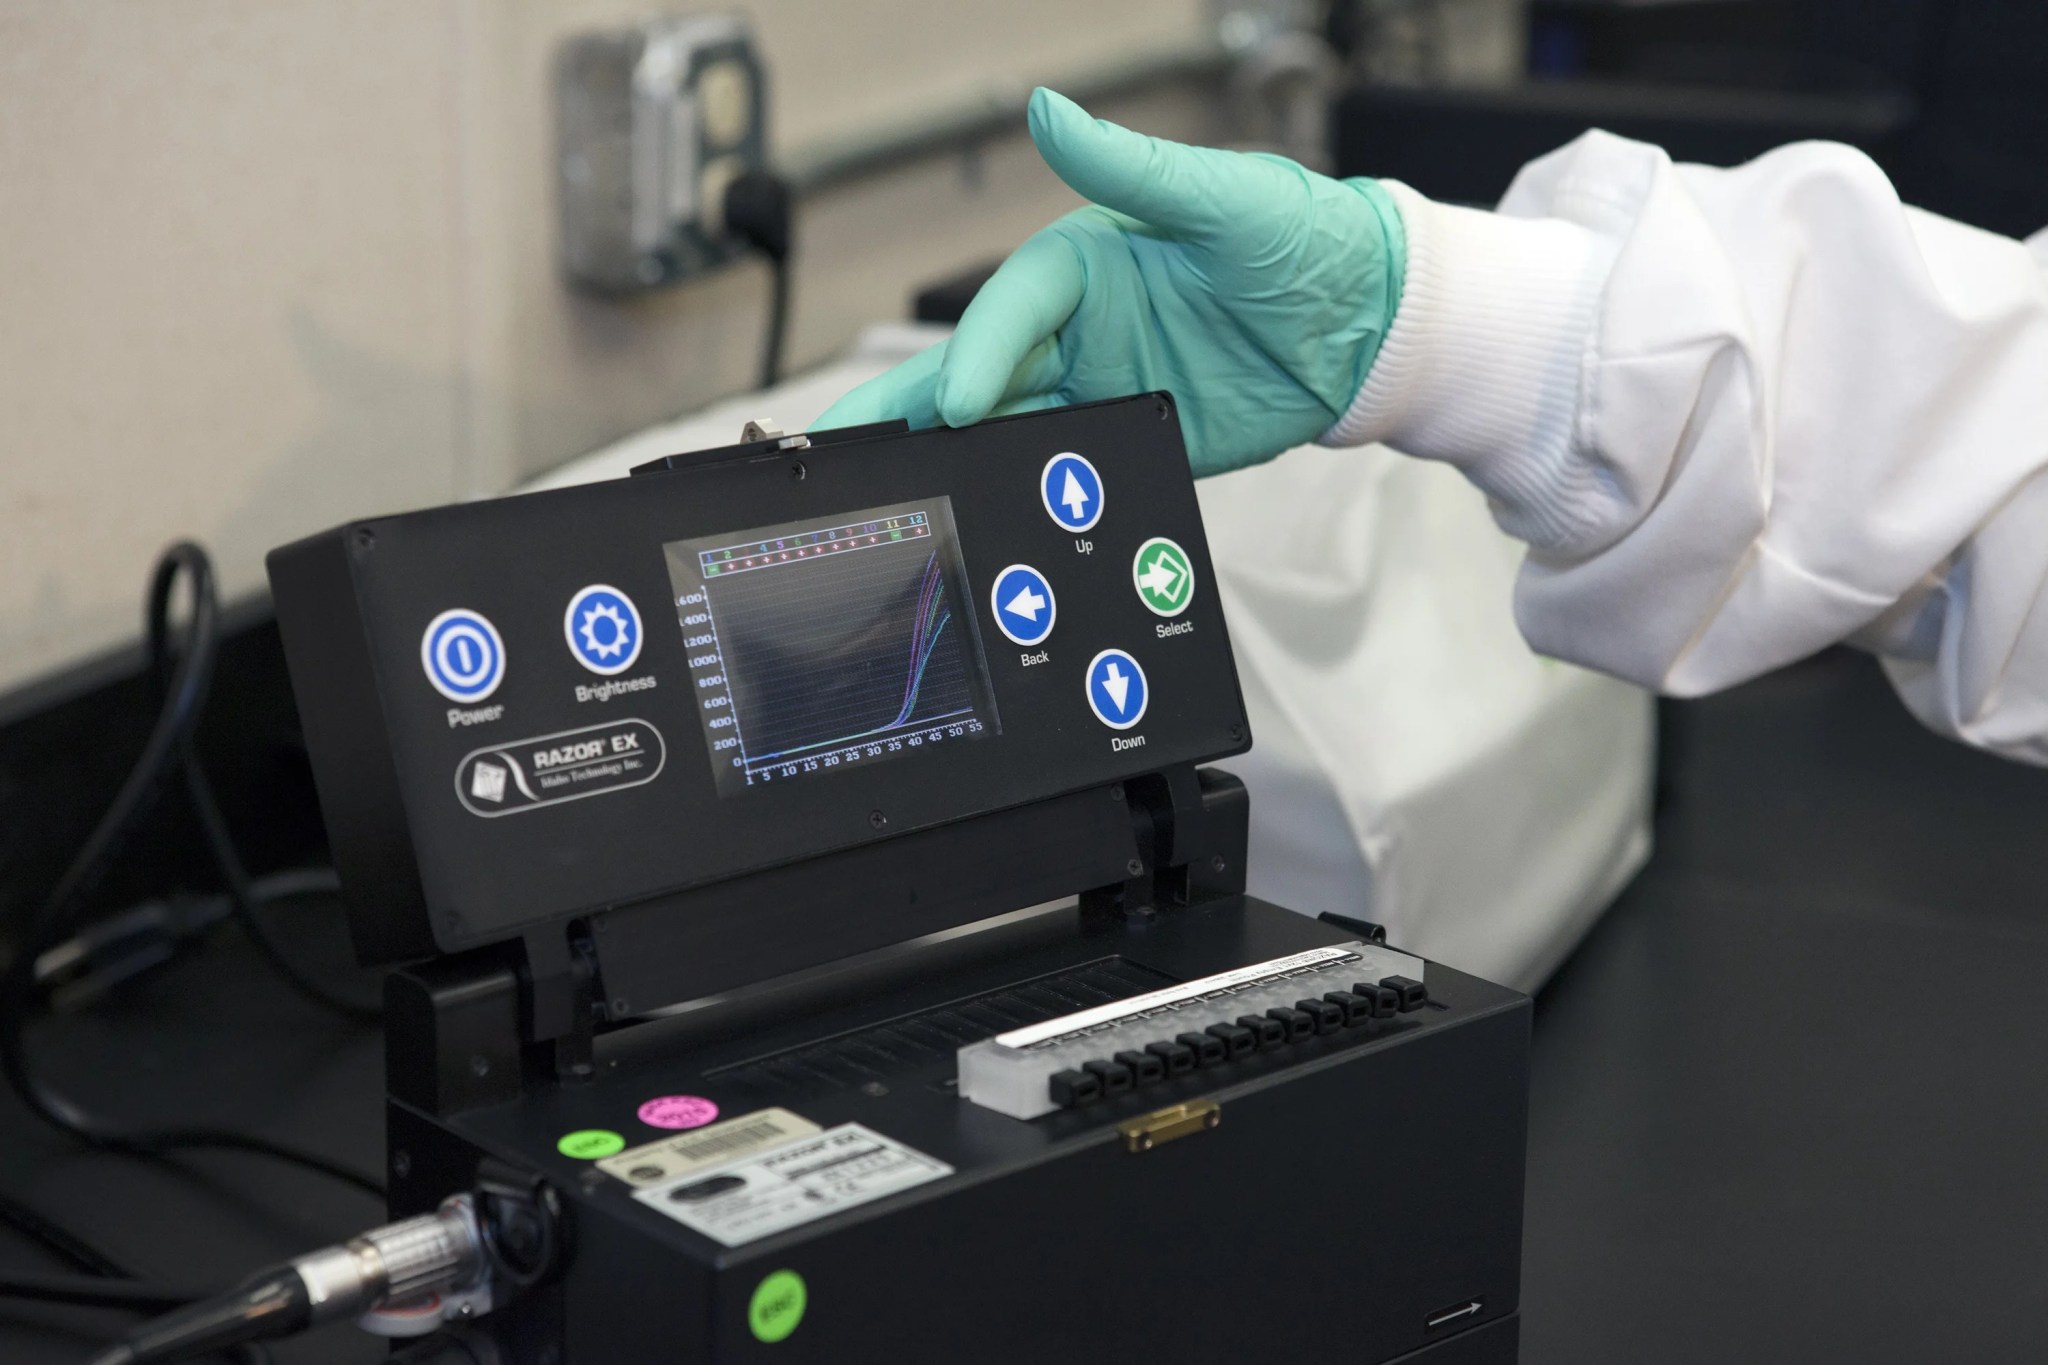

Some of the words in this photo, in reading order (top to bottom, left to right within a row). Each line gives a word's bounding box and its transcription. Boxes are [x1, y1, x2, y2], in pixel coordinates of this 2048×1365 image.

[724, 551, 732, 560] 2
[760, 544, 769, 552] 4
[776, 540, 784, 550] 5
[794, 538, 802, 546] 6
[828, 531, 836, 540] 8
[846, 528, 853, 537] 9
[863, 523, 878, 534] 10
[886, 519, 900, 529] 11
[909, 515, 924, 525] 12
[1075, 539, 1094, 555] Up
[1156, 621, 1194, 638] Select
[688, 654, 717, 668] 1000
[1021, 651, 1050, 667] Back
[575, 676, 657, 702] Brightness
[699, 675, 722, 688] 800
[704, 696, 727, 709] 600
[447, 705, 504, 729] Power
[709, 716, 732, 729] 400
[611, 732, 639, 753] EX
[714, 737, 737, 751] 200
[1111, 735, 1146, 752] Down
[746, 776, 754, 785] 1
[763, 772, 771, 781] 5
[782, 766, 797, 777] 10
[804, 760, 818, 772] 15
[824, 755, 840, 767] 20
[846, 750, 860, 762] 25
[867, 746, 882, 757] 30
[888, 741, 902, 752] 35
[908, 736, 923, 748] 40
[929, 731, 943, 742] 45
[949, 726, 963, 737] 50
[969, 722, 983, 733] 55
[733, 757, 742, 767] 0
[570, 763, 623, 782] Technology
